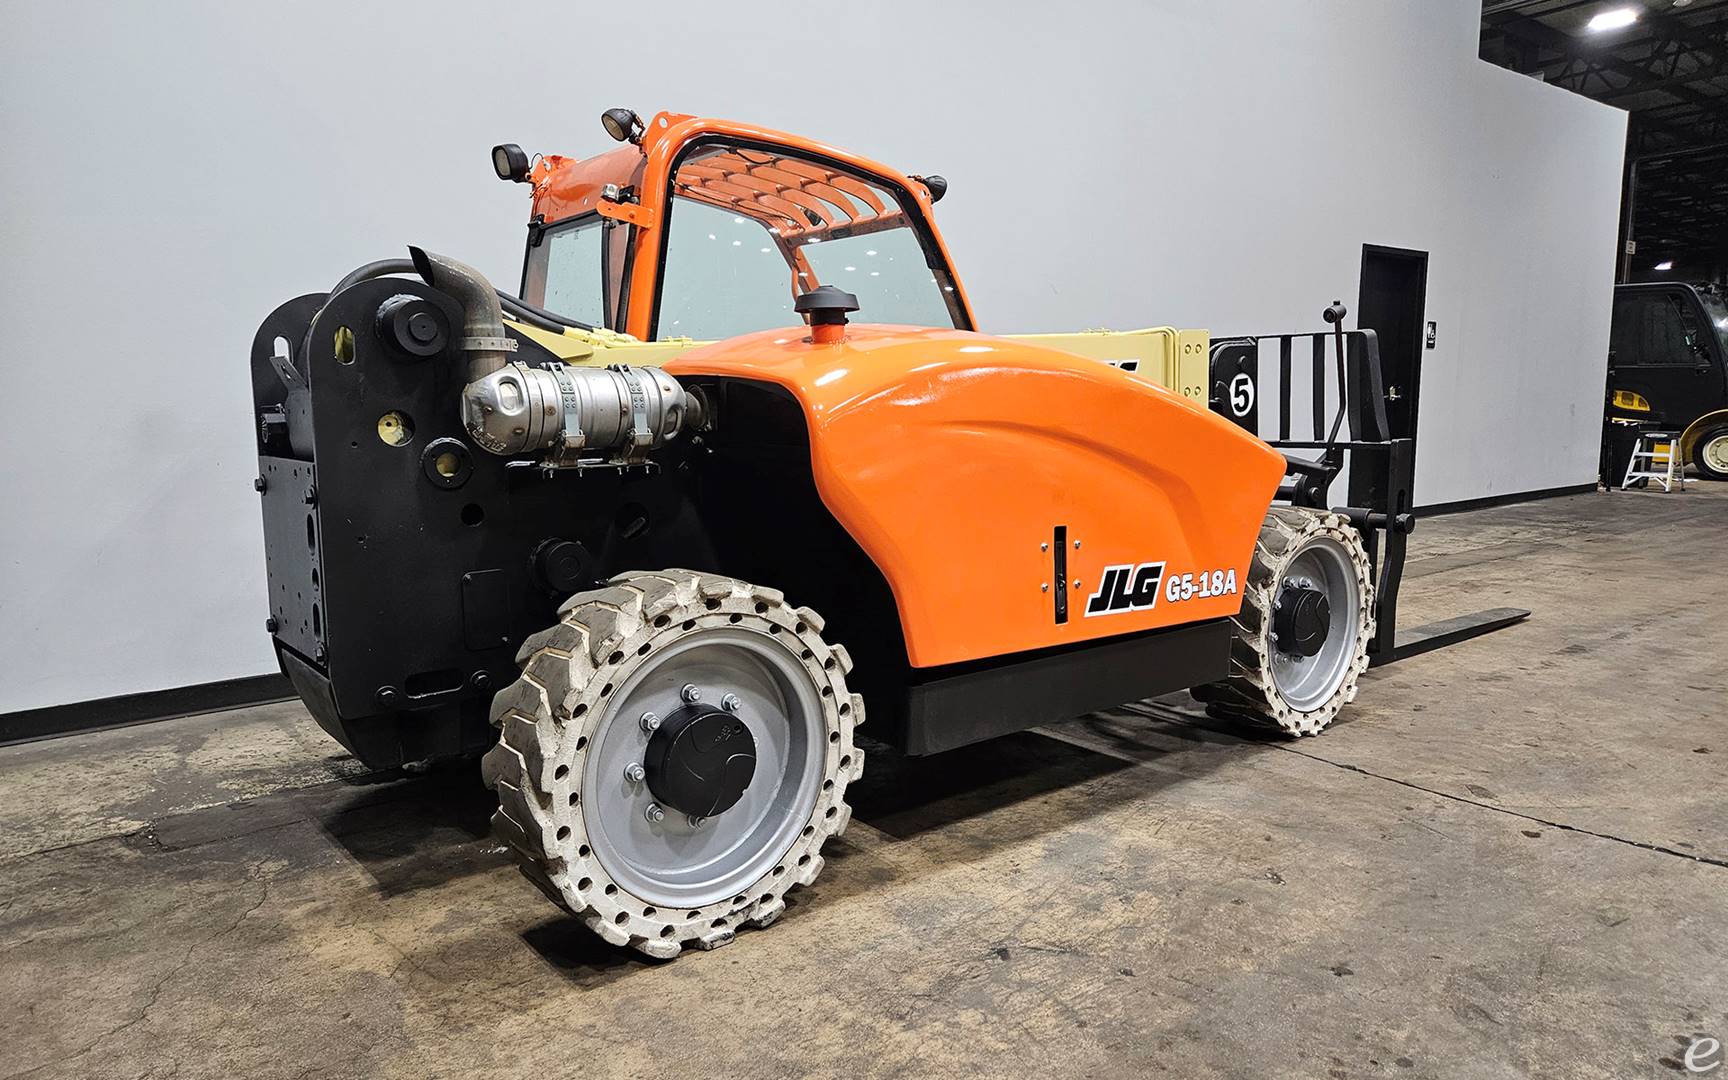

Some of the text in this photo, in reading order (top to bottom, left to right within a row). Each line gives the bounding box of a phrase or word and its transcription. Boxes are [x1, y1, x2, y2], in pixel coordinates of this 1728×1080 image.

[1233, 377, 1250, 413] 5
[1086, 563, 1238, 614] JLG G5-18A
